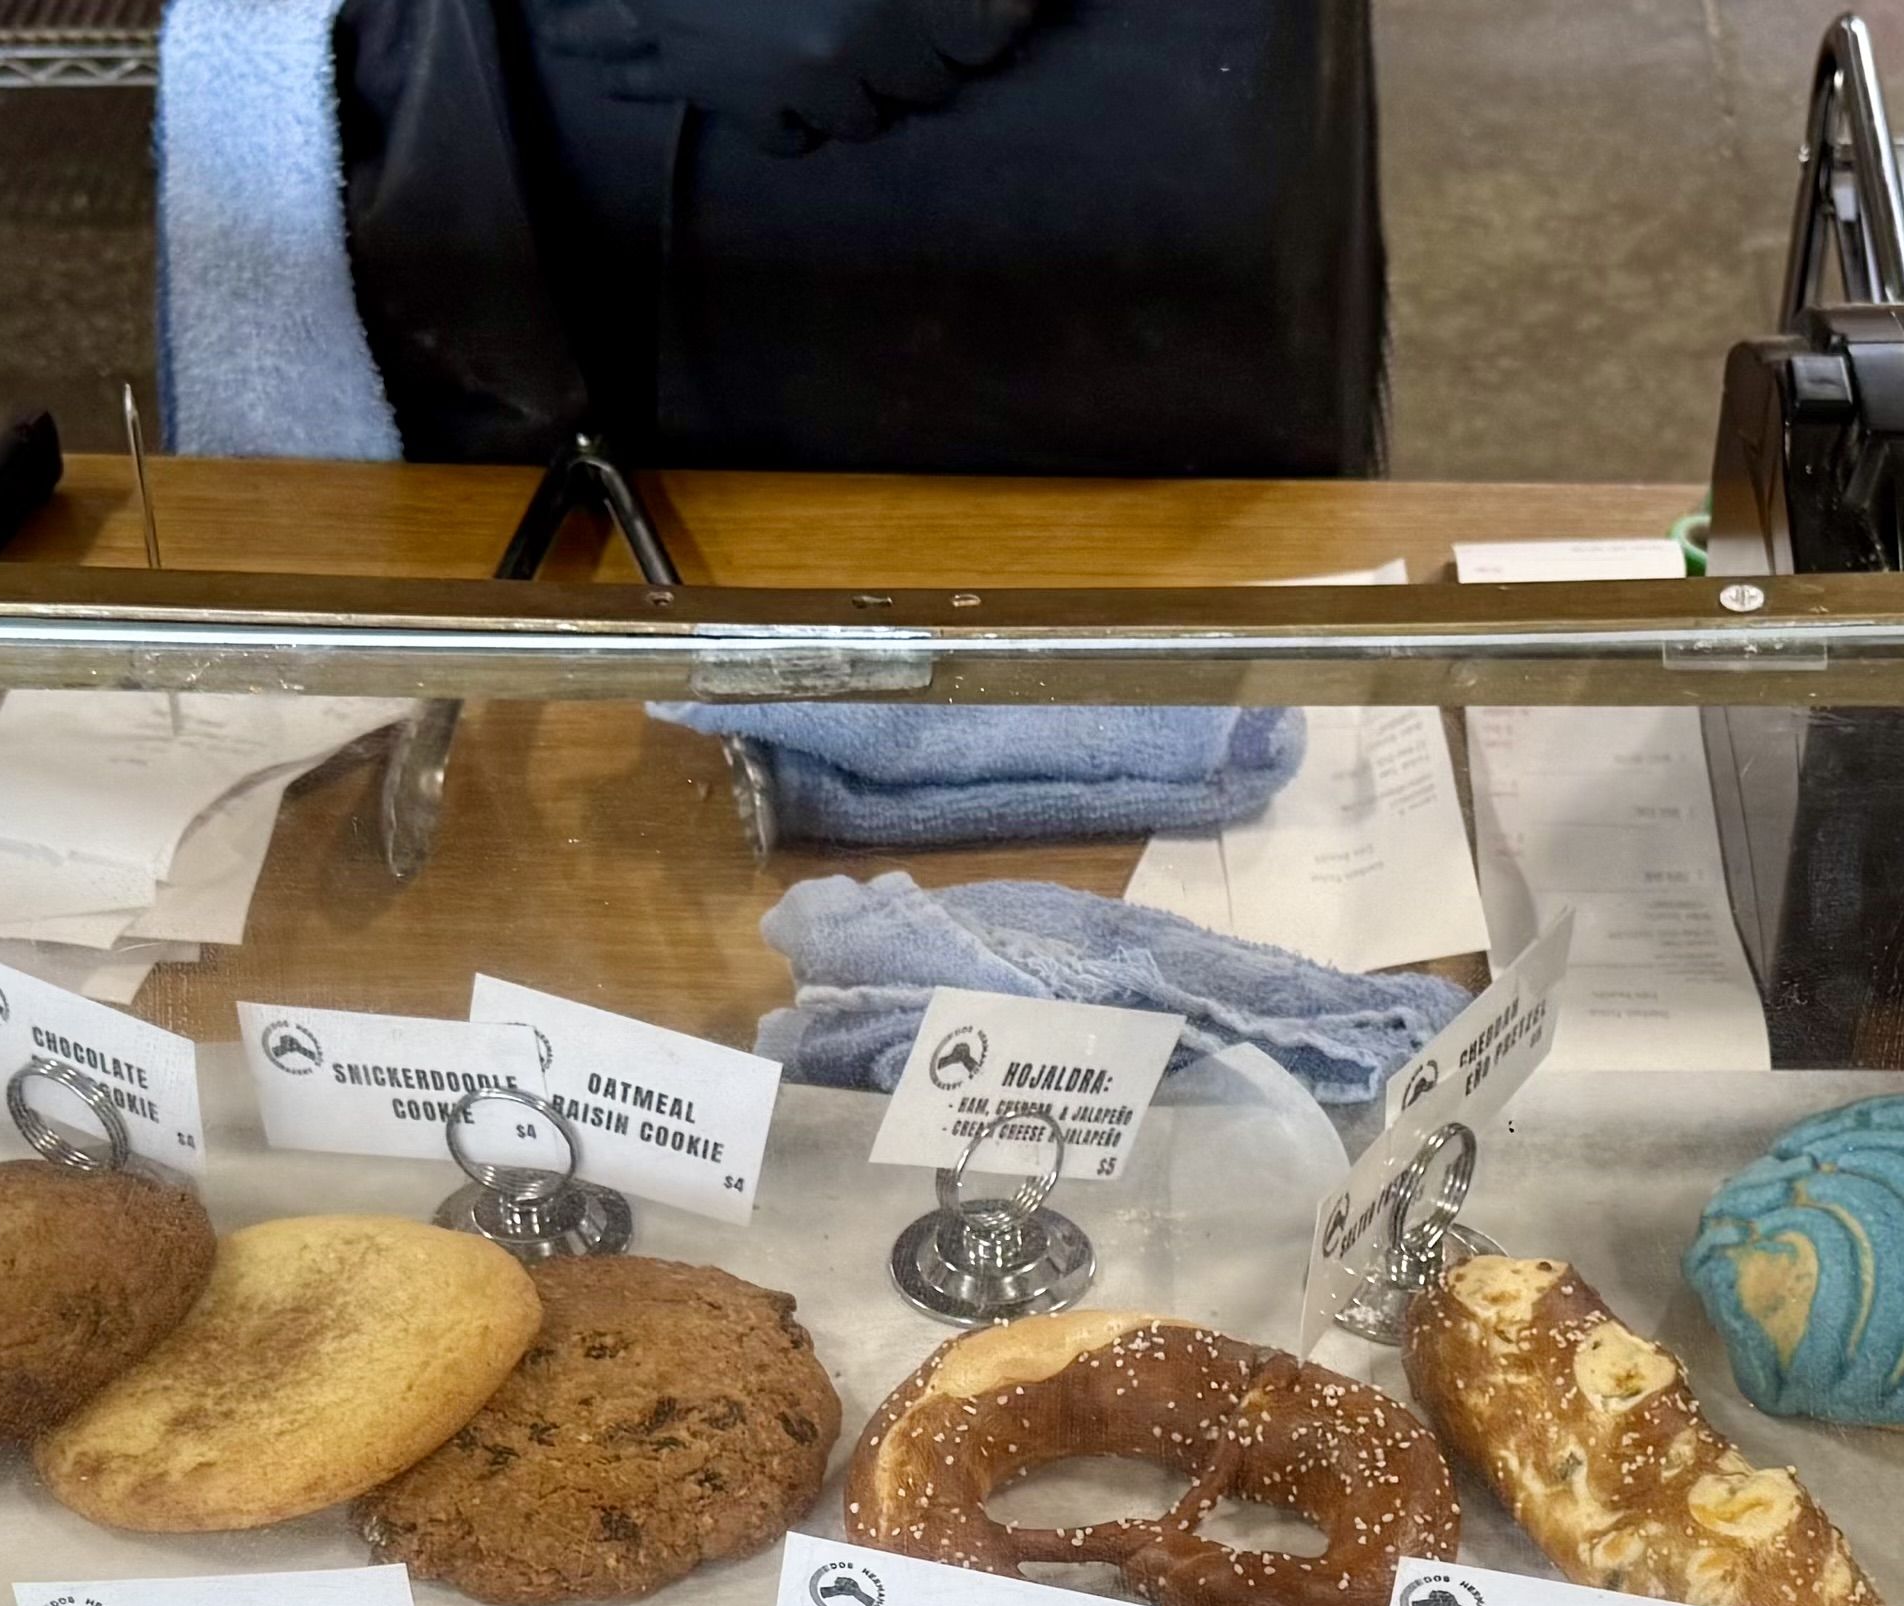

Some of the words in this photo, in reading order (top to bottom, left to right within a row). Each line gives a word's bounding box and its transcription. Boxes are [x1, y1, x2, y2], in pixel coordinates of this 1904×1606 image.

[31, 1026, 149, 1090] CHOCOLATE
[332, 1063, 518, 1091] SNICKERDOODLE
[1001, 1061, 1114, 1095] HOJALDRA:
[88, 1077, 160, 1124] OOKIE
[587, 1073, 696, 1124] OATMEAL
[516, 1123, 538, 1140] $4
[552, 1093, 629, 1136] RAISIN
[639, 1121, 725, 1164] COOKIE
[1096, 1157, 1117, 1175] $5
[723, 1174, 745, 1193] $4
